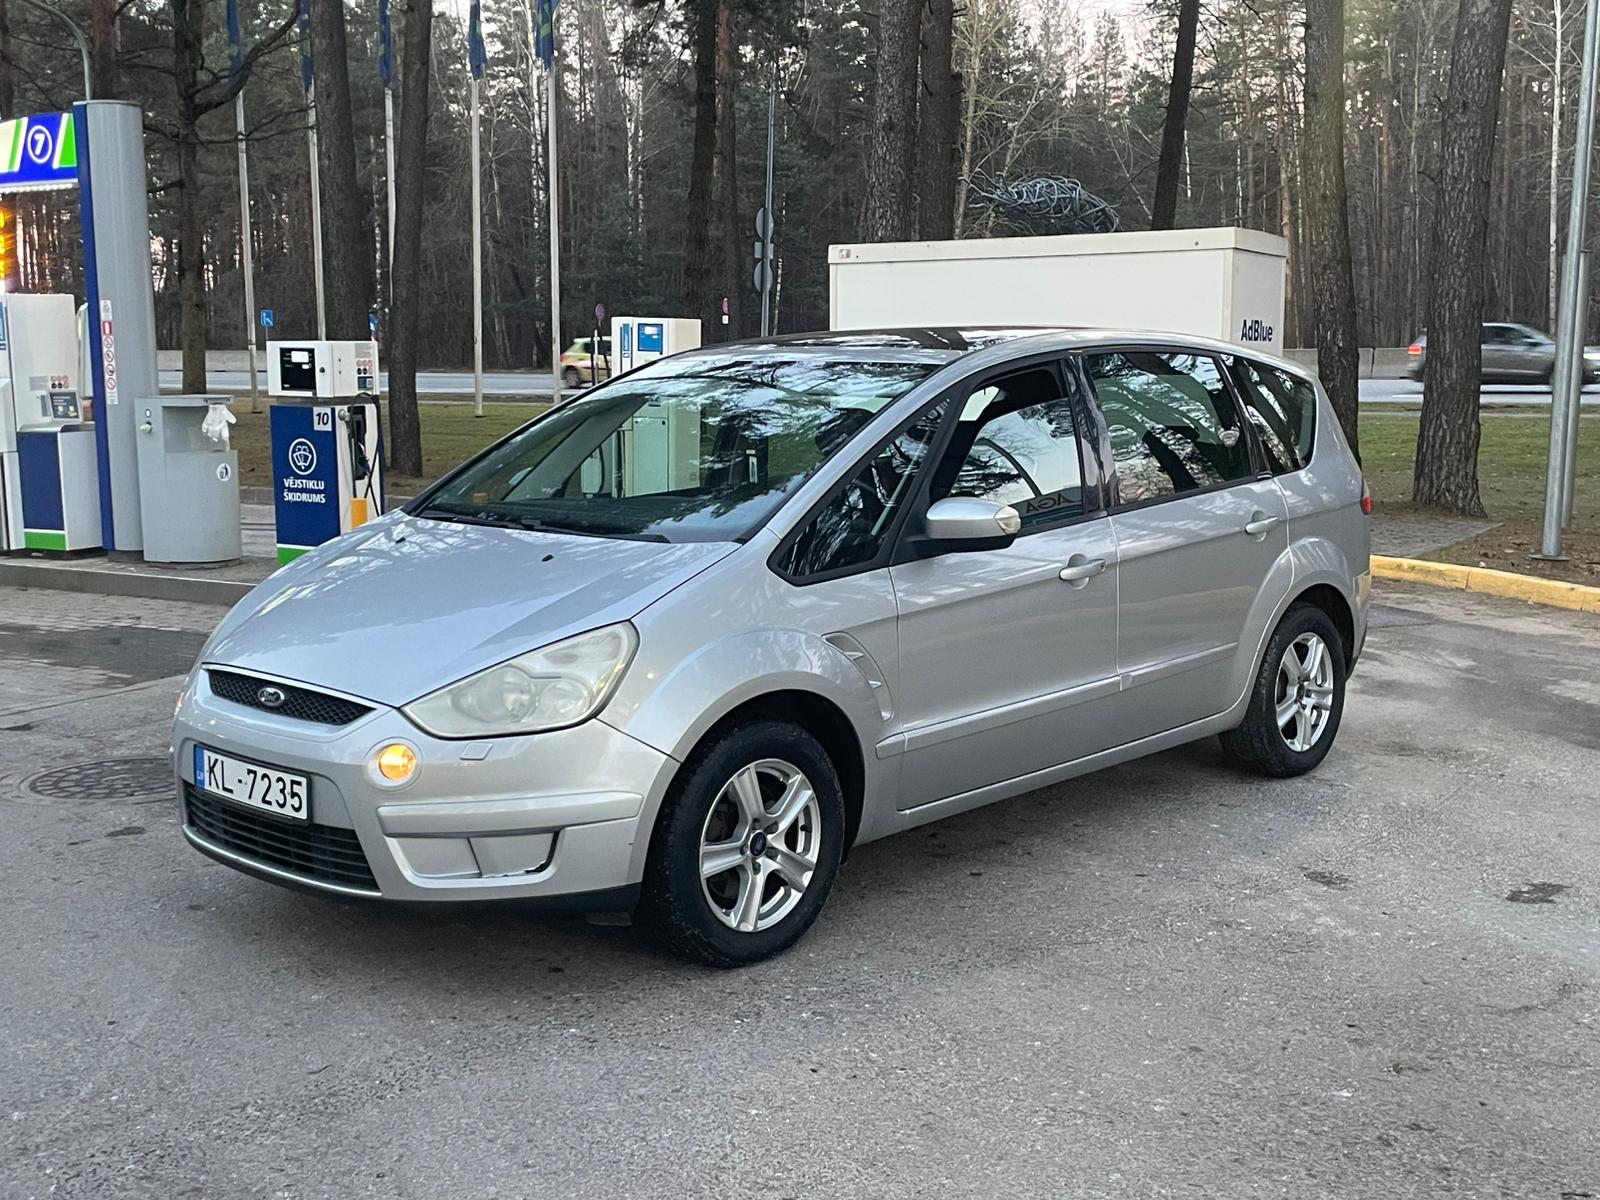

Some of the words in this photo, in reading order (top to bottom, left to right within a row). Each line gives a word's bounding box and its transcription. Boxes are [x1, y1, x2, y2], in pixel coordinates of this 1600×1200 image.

[34, 133, 46, 156] 7
[1241, 319, 1273, 342] AdBlue
[315, 412, 330, 426] 10
[283, 477, 325, 490] VĒJSTIKLU
[283, 489, 326, 504] ŠĶIDRUMS
[208, 756, 303, 813] KL-7235
